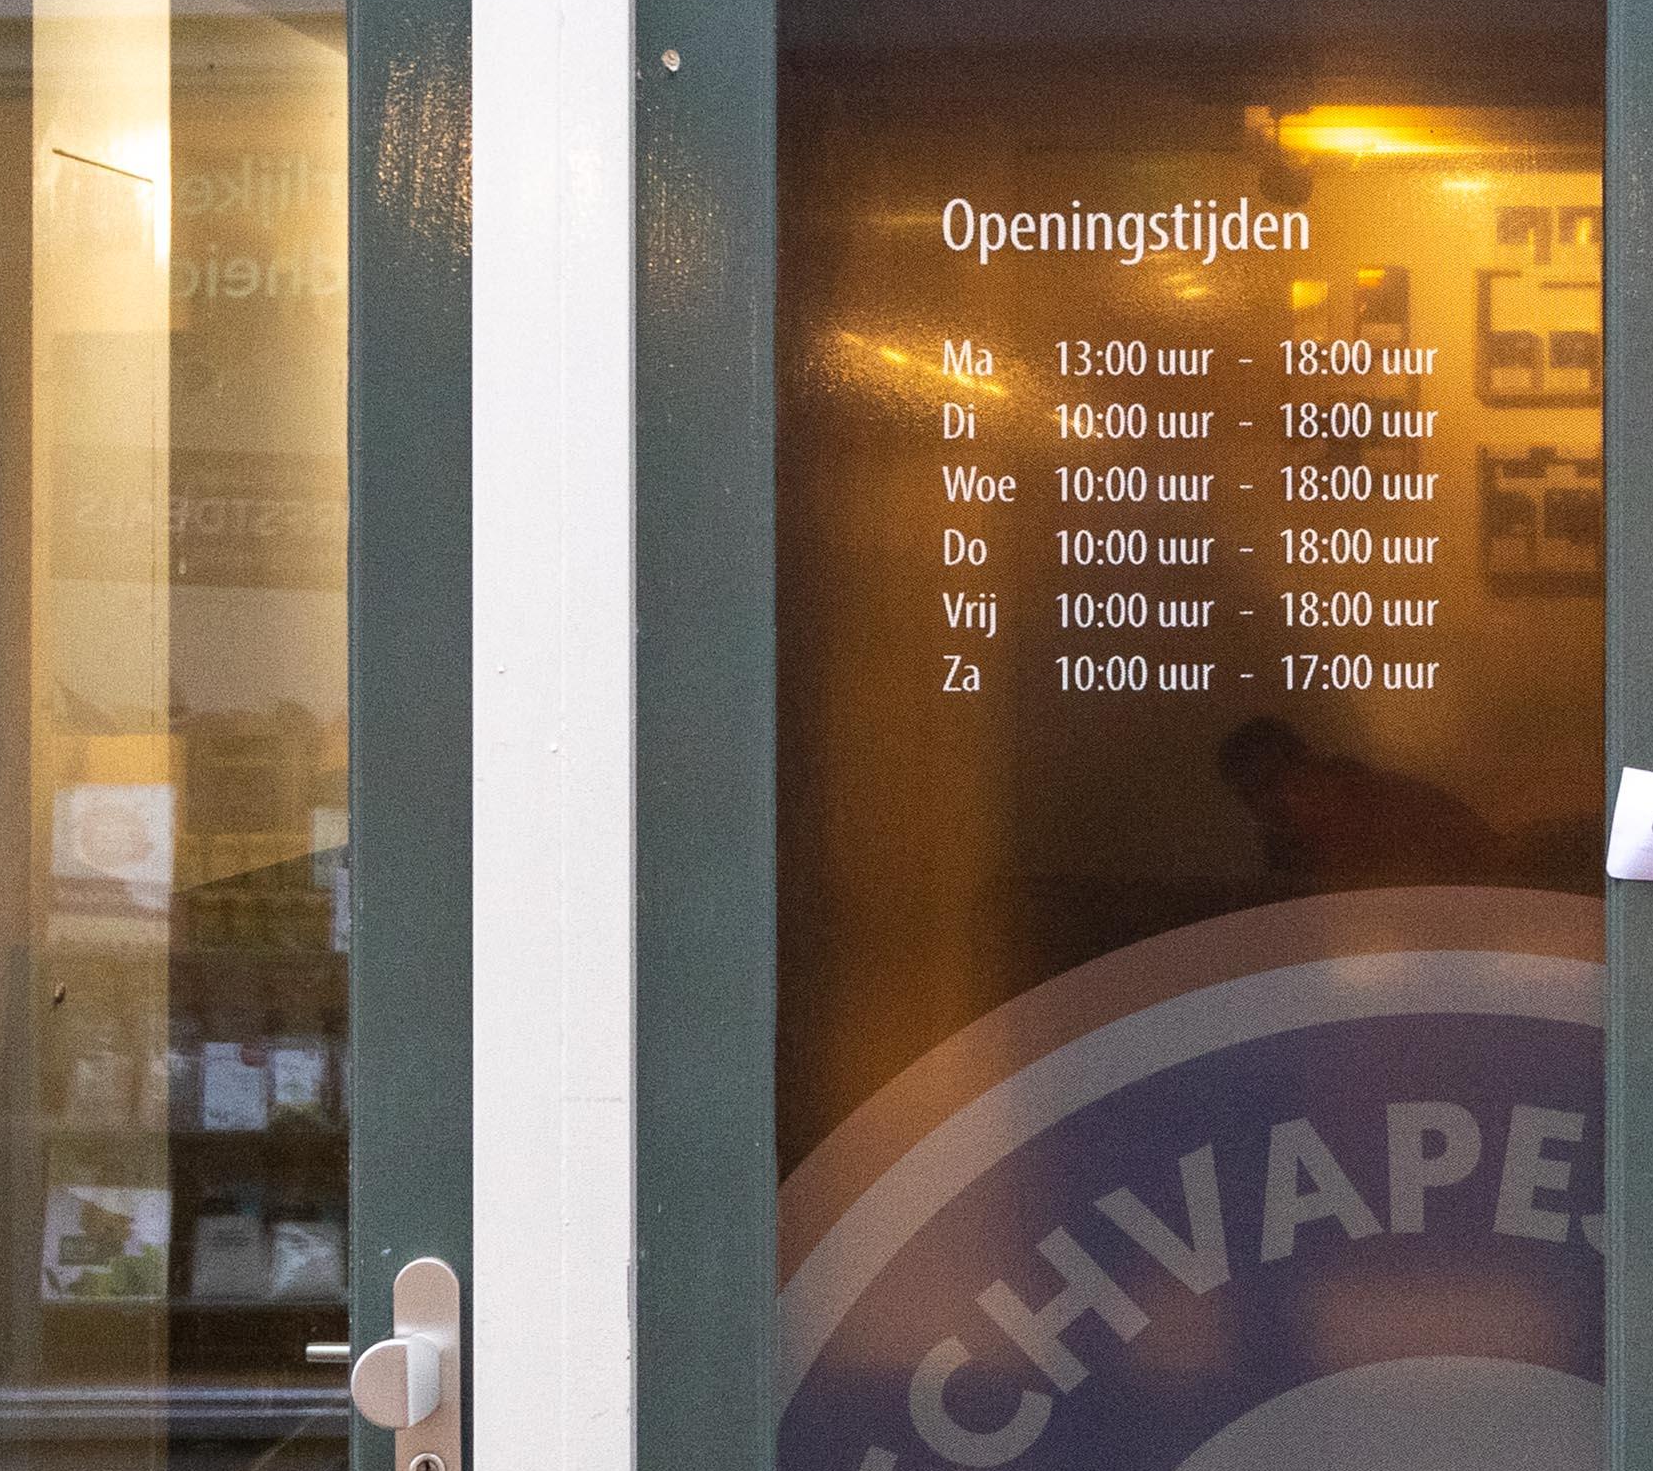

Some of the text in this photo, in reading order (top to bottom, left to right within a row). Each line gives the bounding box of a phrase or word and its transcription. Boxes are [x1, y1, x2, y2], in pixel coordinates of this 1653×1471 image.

[941, 196, 1311, 267] Openingstijden
[942, 339, 994, 377] Ma
[1056, 340, 1148, 377] 13:00
[1158, 349, 1214, 377] uur
[1281, 339, 1373, 376] 18:00
[1382, 348, 1439, 376] uur
[943, 402, 976, 440] Di
[1056, 403, 1148, 440] 10:00
[1158, 412, 1214, 440] uur
[1281, 402, 1373, 439] 18:00
[1382, 411, 1439, 439] uur
[942, 466, 1017, 503] Woe
[1056, 466, 1148, 503] 10:00
[1158, 475, 1214, 503] uur
[1281, 465, 1373, 502] 18:00
[1382, 474, 1439, 502] uur
[944, 529, 988, 566] Do
[1056, 529, 1148, 566] 10:00
[1158, 538, 1214, 566] uur
[1281, 528, 1373, 565] 18:00
[1382, 537, 1439, 565] uur
[943, 593, 998, 638] Vrij
[1056, 592, 1148, 629] 10:00
[1158, 601, 1214, 629] uur
[1281, 591, 1373, 628] 18:00
[1382, 600, 1439, 628] uur
[943, 656, 981, 692] Za
[1056, 656, 1148, 693] 10:00
[1158, 665, 1214, 693] uur
[1281, 655, 1373, 692] 17:00
[1382, 664, 1439, 692] uur
